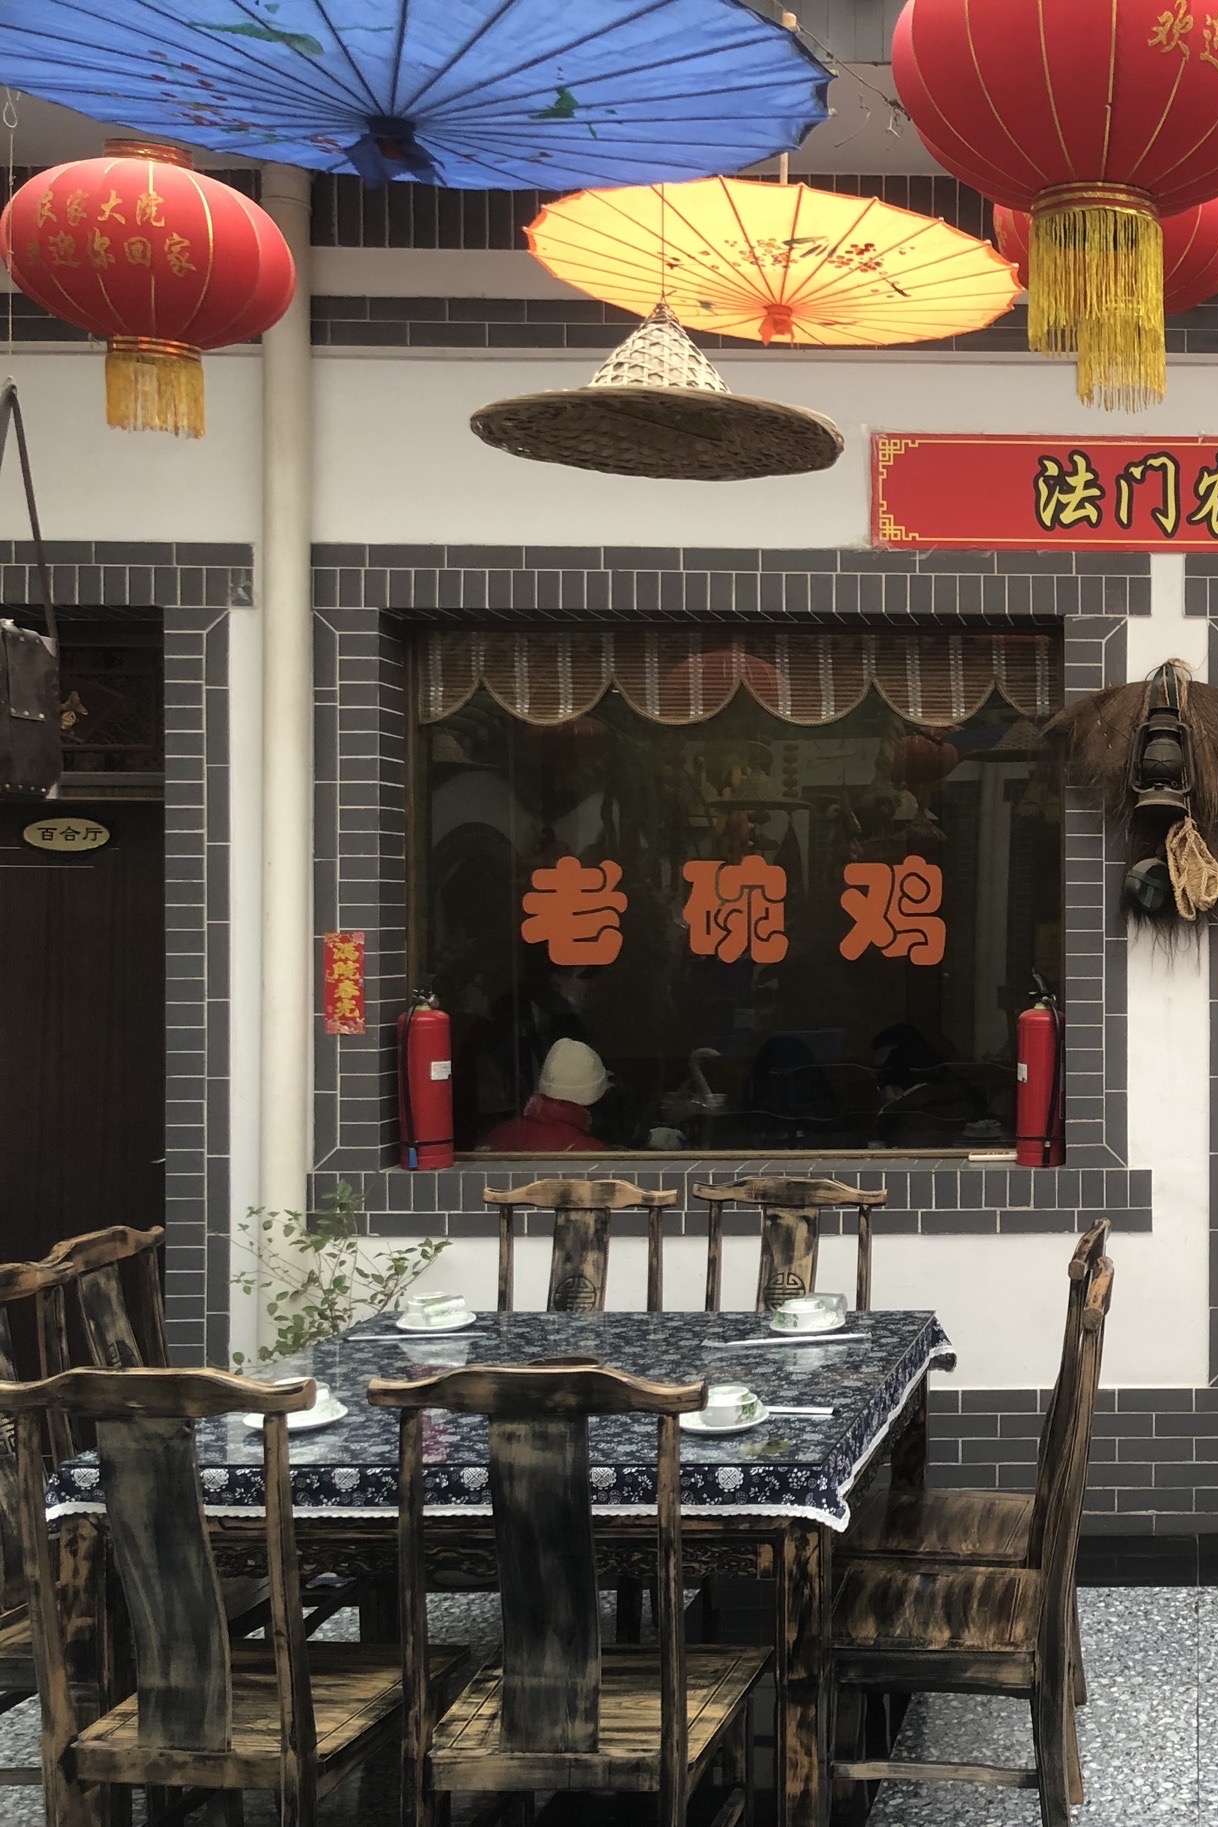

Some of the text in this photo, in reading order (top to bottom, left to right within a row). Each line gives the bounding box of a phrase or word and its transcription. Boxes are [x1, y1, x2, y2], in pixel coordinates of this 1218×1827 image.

[37, 826, 103, 842] 百合厅
[521, 855, 947, 966] 老碗鸡
